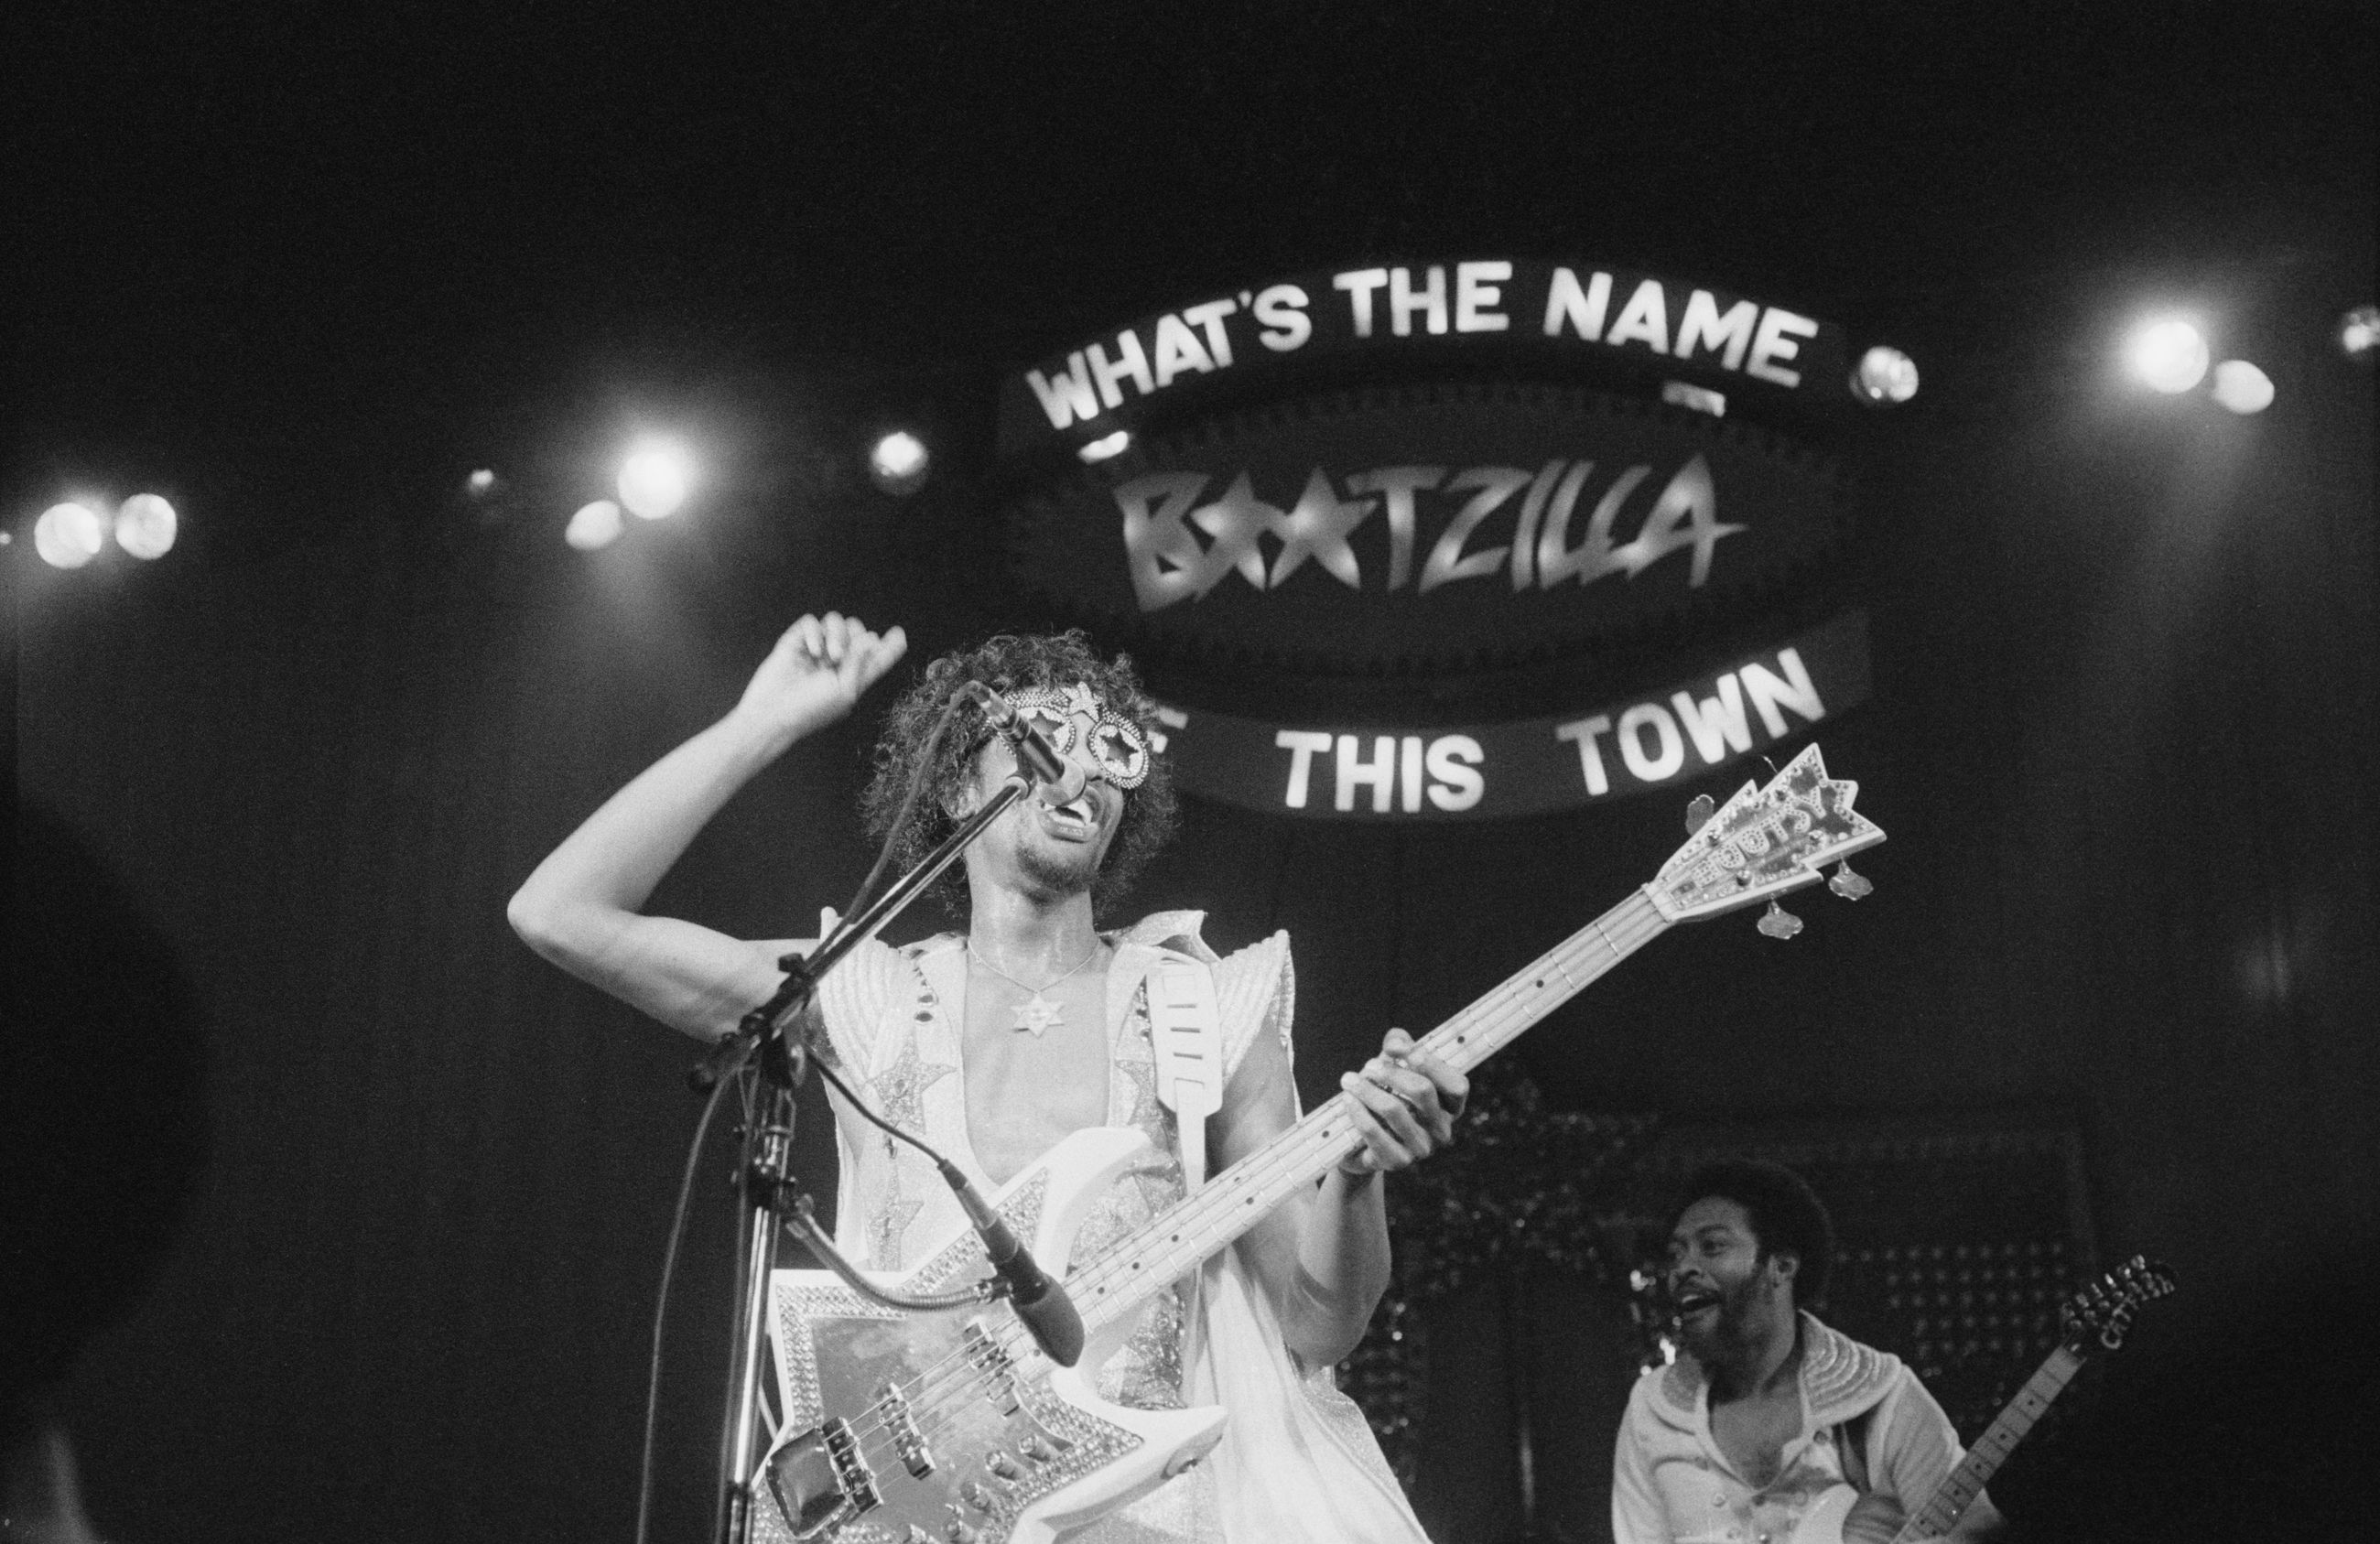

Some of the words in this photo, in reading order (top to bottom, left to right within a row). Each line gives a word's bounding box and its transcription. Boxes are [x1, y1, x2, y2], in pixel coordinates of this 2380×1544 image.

[1027, 283, 1313, 430] WHAT'S
[1333, 261, 1513, 337] THE
[1544, 267, 1820, 387] NAME
[1274, 730, 1486, 814] THIS
[1556, 647, 1825, 797] TOWN
[1691, 785, 1827, 889] BOOTSY
